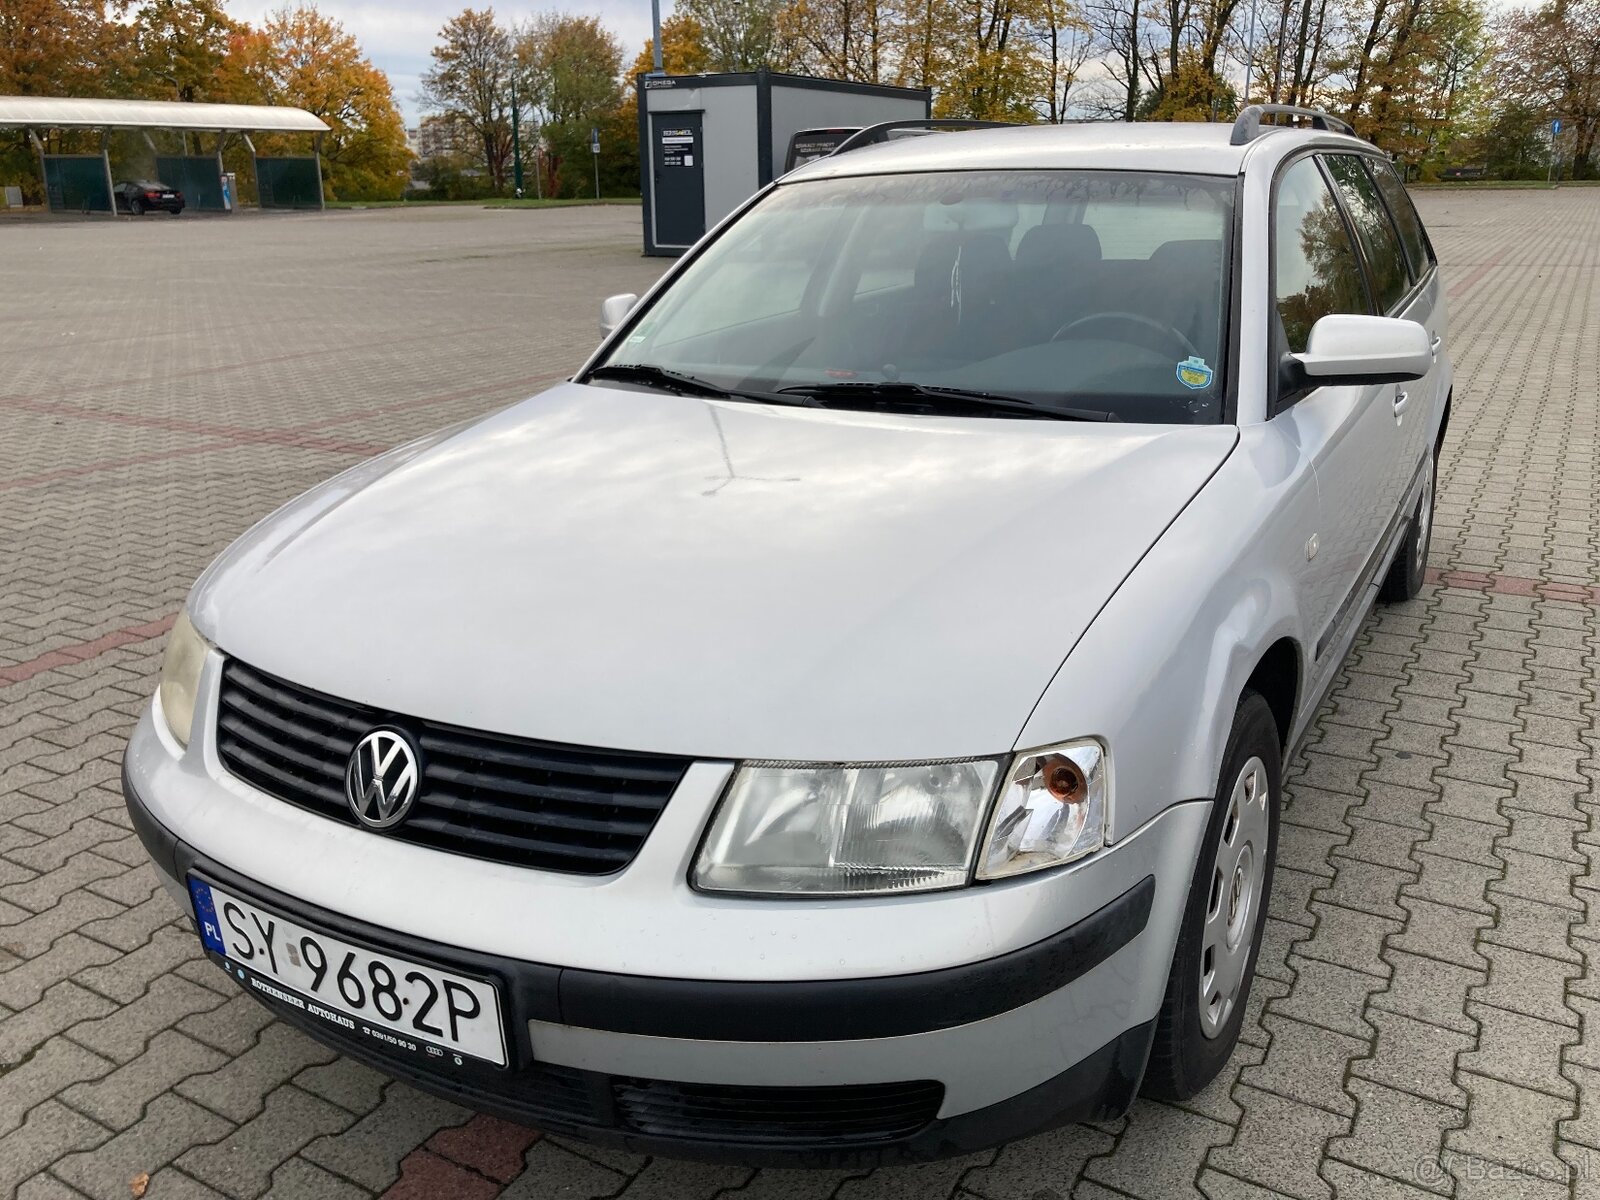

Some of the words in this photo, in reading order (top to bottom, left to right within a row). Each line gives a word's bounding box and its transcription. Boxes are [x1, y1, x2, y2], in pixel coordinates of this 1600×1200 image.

[203, 921, 222, 942] PL
[300, 936, 481, 1042] 9682P
[307, 1003, 356, 1030] AUTOHAUS
